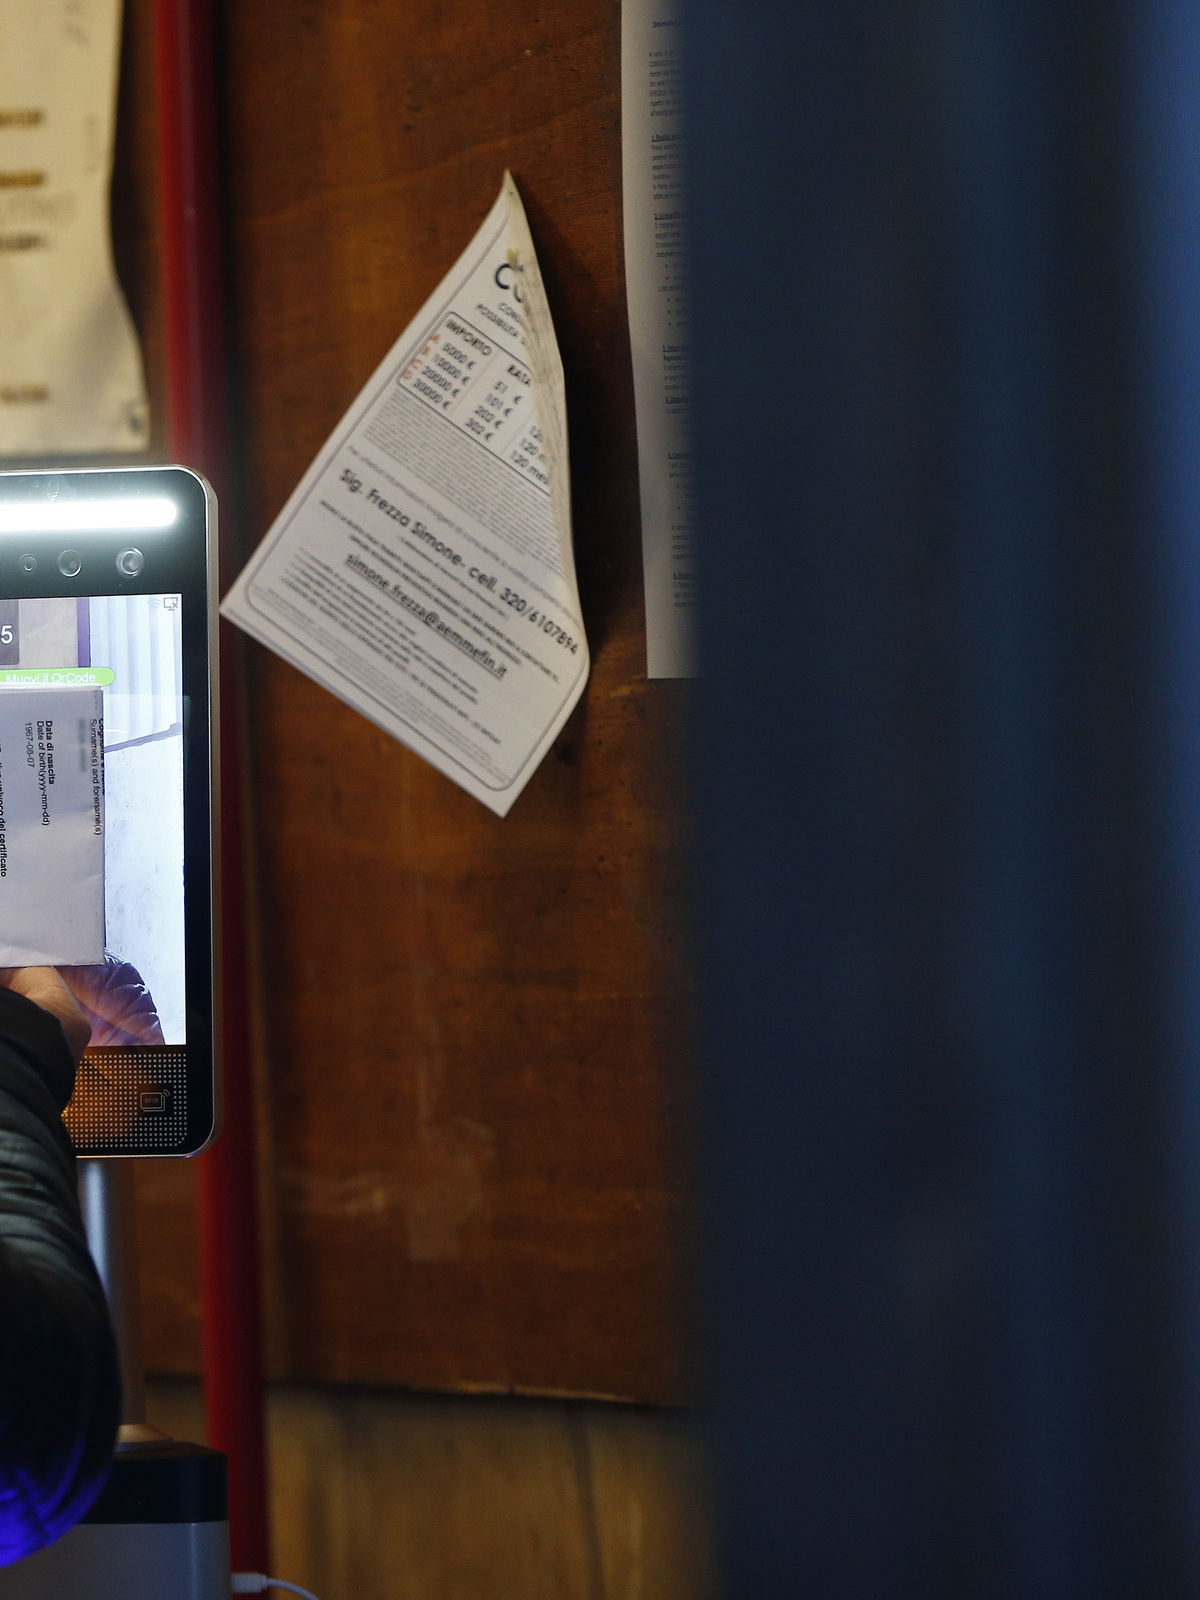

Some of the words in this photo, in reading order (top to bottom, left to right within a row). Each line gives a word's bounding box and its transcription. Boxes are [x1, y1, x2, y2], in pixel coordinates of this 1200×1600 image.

[446, 319, 492, 356] IMPORTO
[507, 364, 531, 386] RATA
[421, 365, 453, 392] 20000
[474, 405, 495, 423] 202
[434, 355, 462, 380] 10000
[486, 393, 504, 411] 101
[465, 417, 486, 435] 302
[340, 468, 363, 494] Sig.
[366, 488, 411, 528] Frezza
[410, 521, 466, 567] Simone-
[468, 567, 498, 594] cell.
[51, 672, 96, 684] QrCode
[24, 721, 35, 768] 1967-08-07
[36, 720, 45, 741] Date
[37, 742, 46, 751] of
[45, 720, 53, 741] Data
[46, 742, 54, 752] di
[90, 718, 100, 767] Surname(s)
[37, 752, 51, 826] birth(yyyy-mm-dd)
[46, 753, 56, 785] nascita
[91, 768, 101, 784] and
[92, 785, 103, 836] forename(s)
[0, 833, 8, 878] certificato
